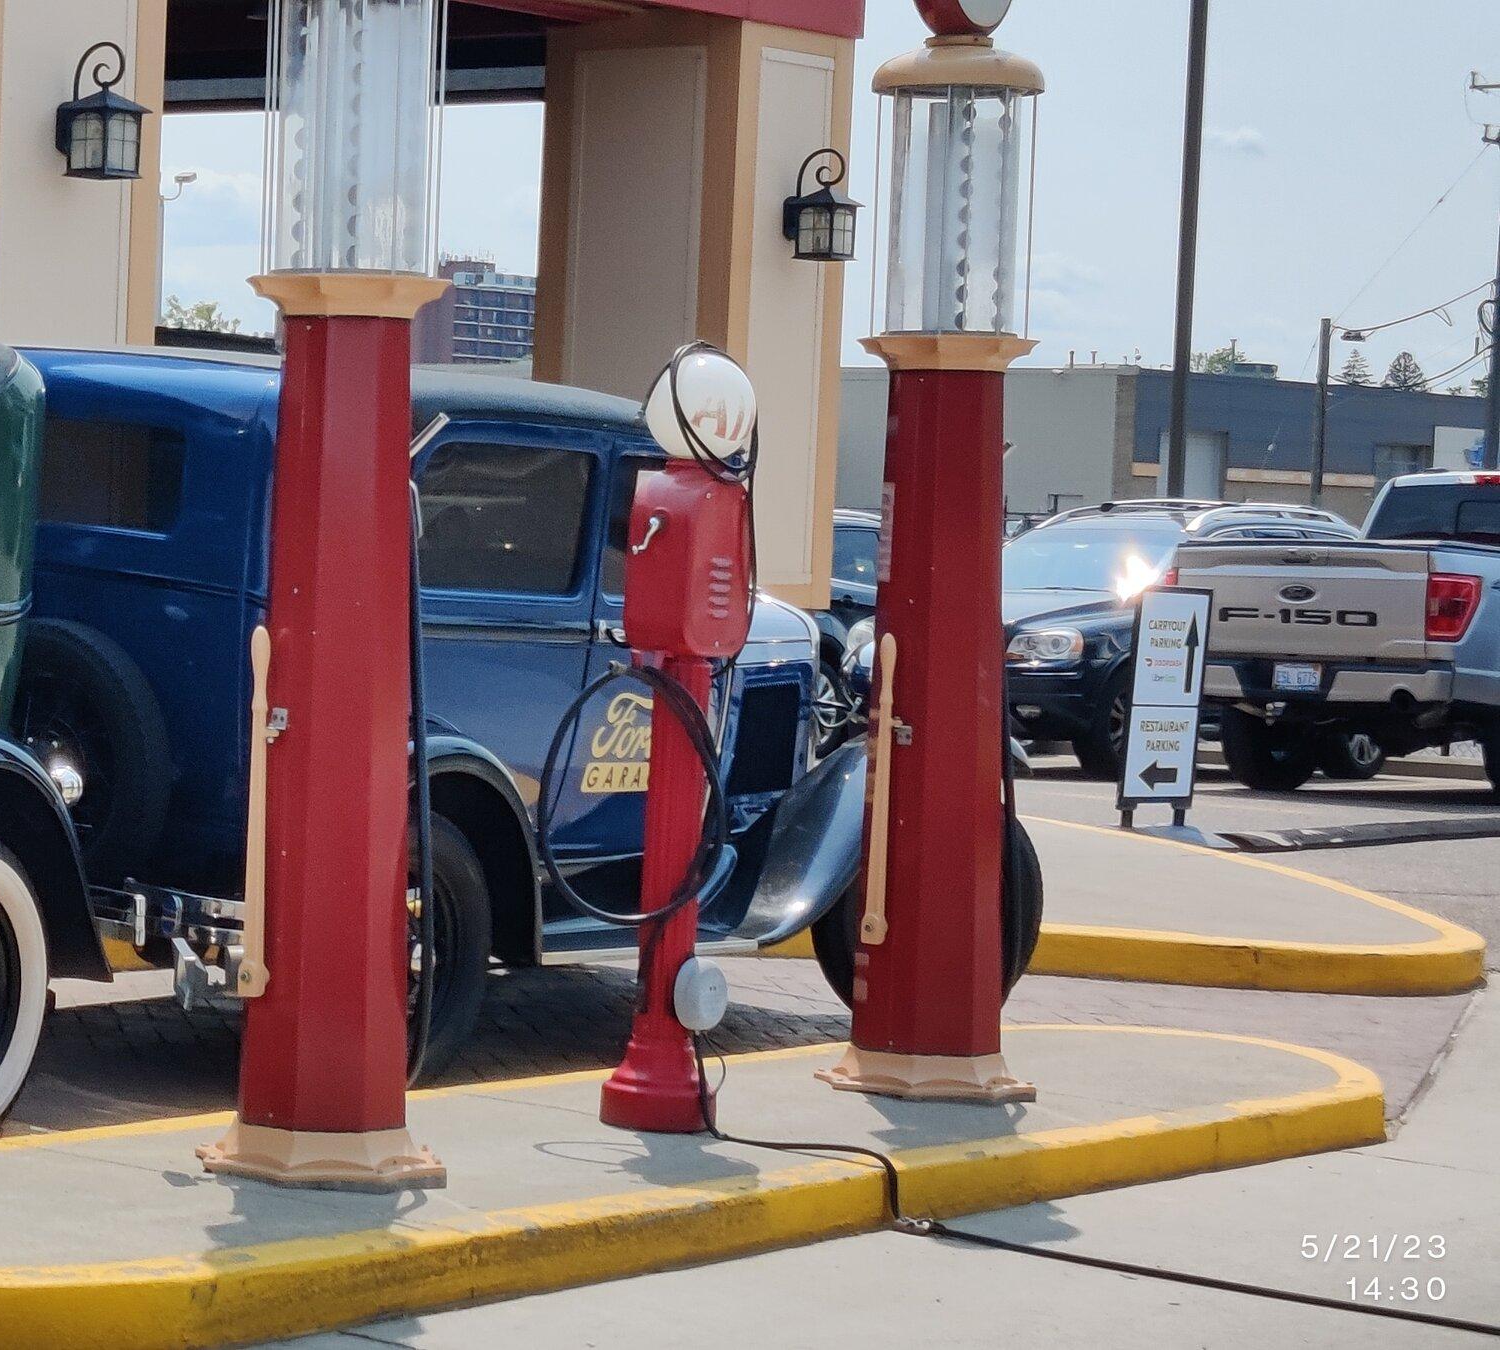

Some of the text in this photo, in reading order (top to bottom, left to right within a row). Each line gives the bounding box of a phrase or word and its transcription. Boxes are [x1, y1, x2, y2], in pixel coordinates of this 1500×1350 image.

[1219, 607, 1377, 627] F-150
[1148, 620, 1186, 631] CARRYOUT
[1150, 638, 1182, 649] PARKING
[592, 693, 653, 758] For
[1140, 721, 1189, 732] RESTAURANT
[1145, 740, 1180, 751] PARKING
[586, 766, 648, 788] GARA
